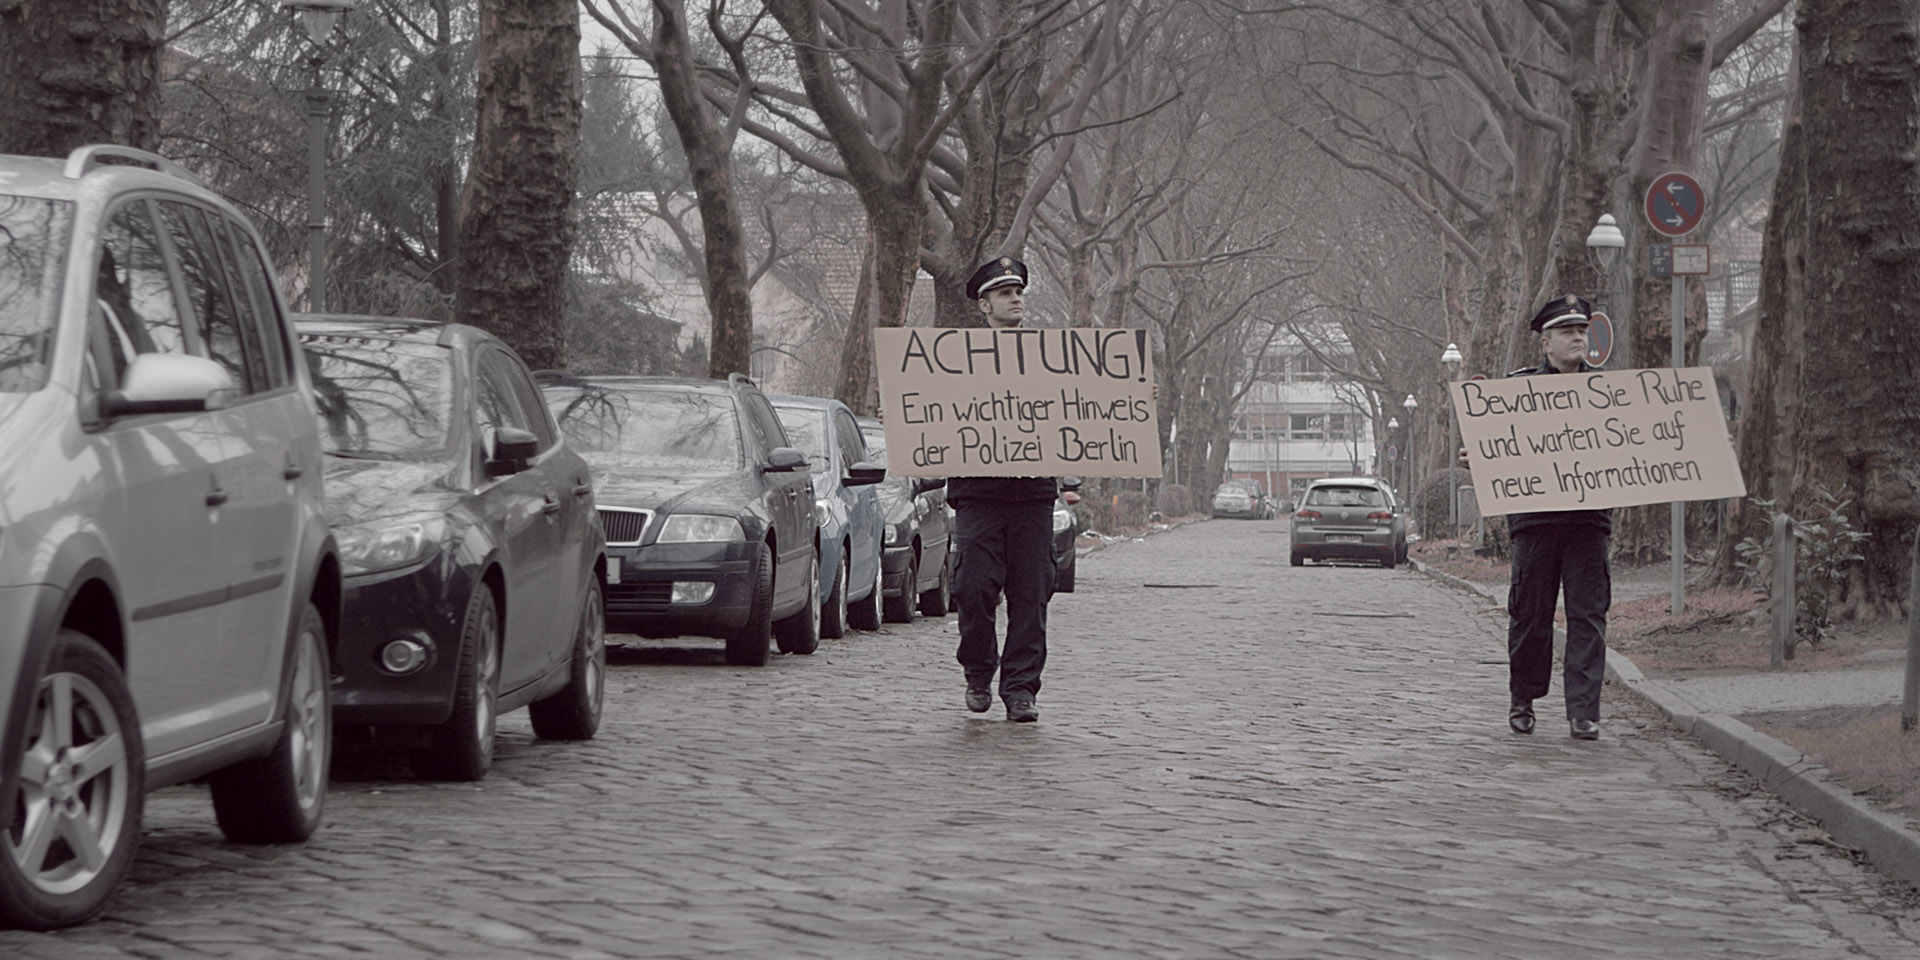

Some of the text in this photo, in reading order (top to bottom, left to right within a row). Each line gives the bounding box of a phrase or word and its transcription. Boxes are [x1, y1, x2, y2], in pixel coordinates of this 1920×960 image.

[901, 329, 1146, 382] ACHTUNG!
[902, 388, 1149, 433] Ein wichtiger Hinweis
[1461, 370, 1705, 417] Bewahren Sie Ruhe
[913, 427, 1137, 467] der Polizei Berlin
[1479, 411, 1684, 459] und warten Sie auf
[1492, 457, 1701, 502] neue Informationen
